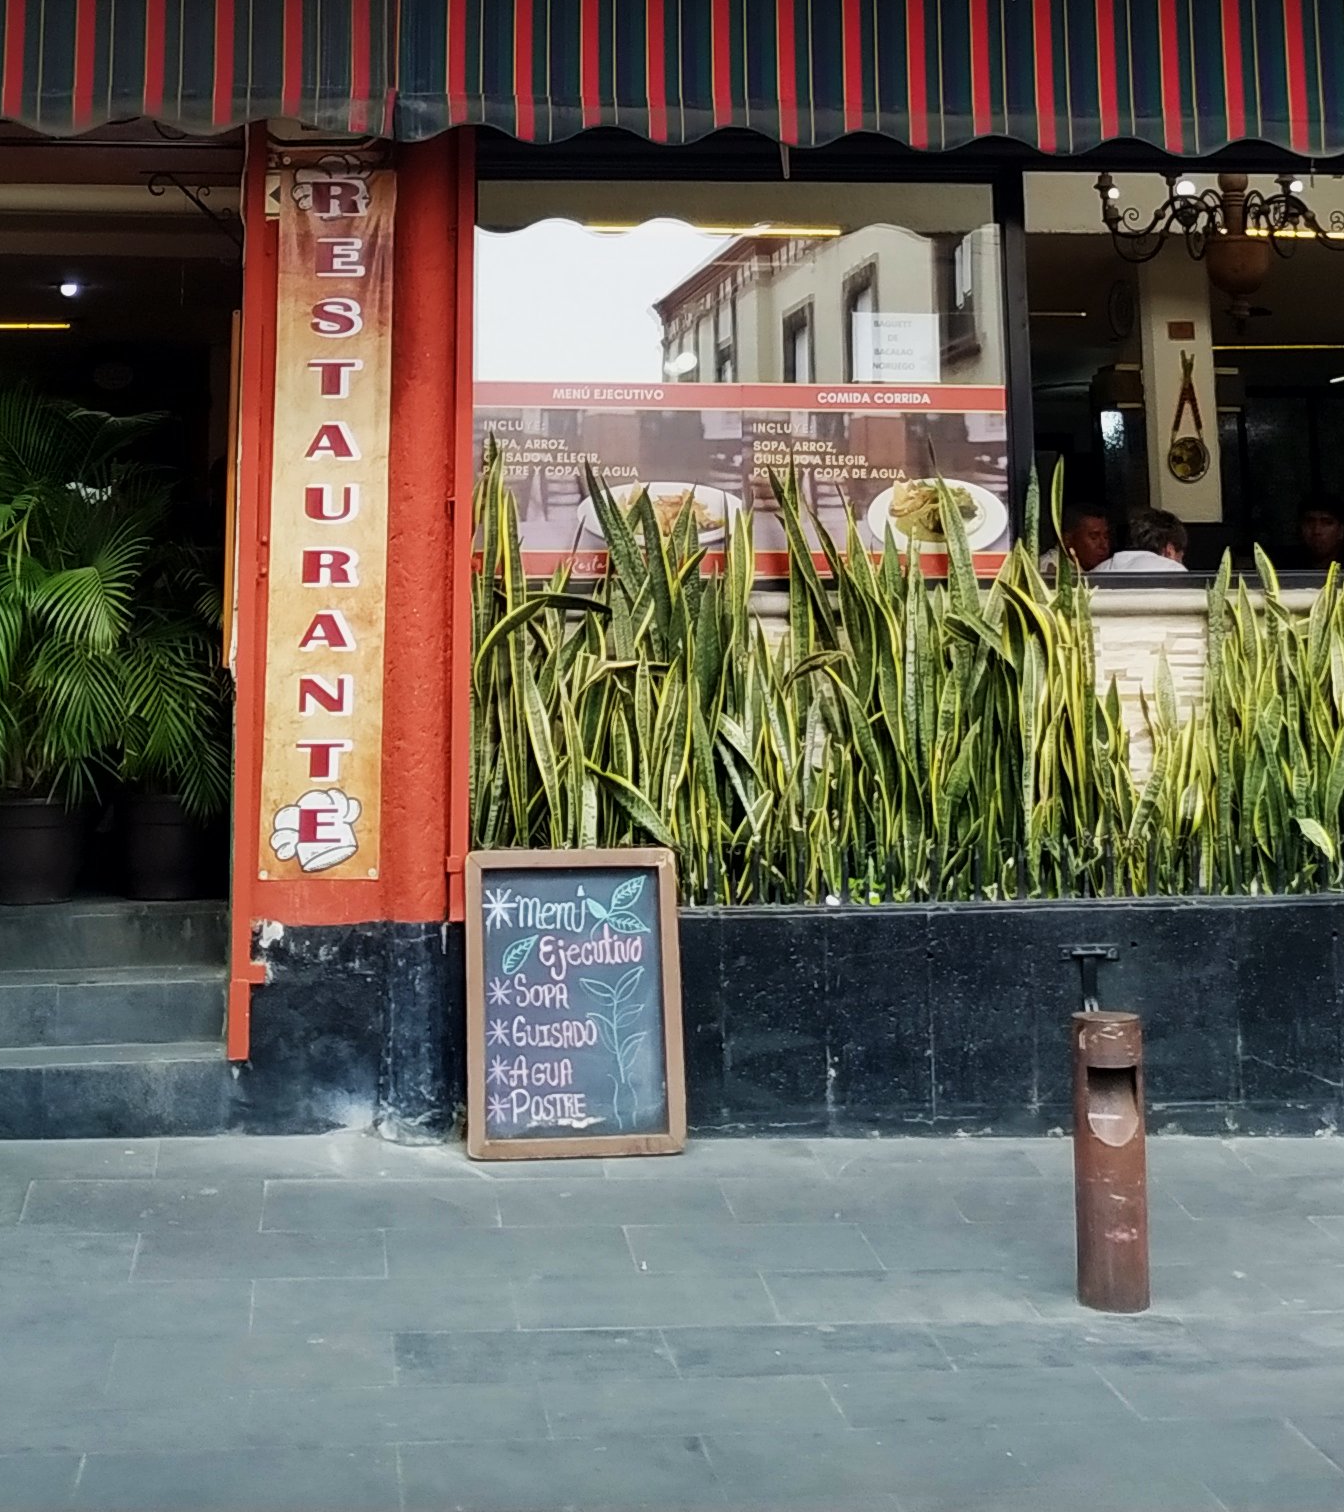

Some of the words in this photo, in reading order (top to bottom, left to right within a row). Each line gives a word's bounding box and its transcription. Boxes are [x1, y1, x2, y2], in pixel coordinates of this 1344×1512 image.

[553, 386, 590, 400] MENÚ
[594, 389, 664, 401] EJECUTIVO
[817, 392, 871, 404] COMIDA
[874, 393, 931, 405] CORRIDA
[525, 439, 569, 451] ARROZ,
[753, 440, 791, 453] SOPA,
[793, 441, 837, 454] ARROZ,
[557, 453, 601, 465] ELEGIR,
[825, 454, 869, 467] ELEGIR,
[533, 466, 542, 476] Y
[545, 466, 581, 476] COPA
[602, 466, 639, 477] AGUA
[802, 468, 811, 478] Y
[814, 467, 850, 479] COPA
[852, 468, 868, 479] DE
[870, 468, 906, 479] AGUA
[296, 179, 366, 844] RESTAURANTE
